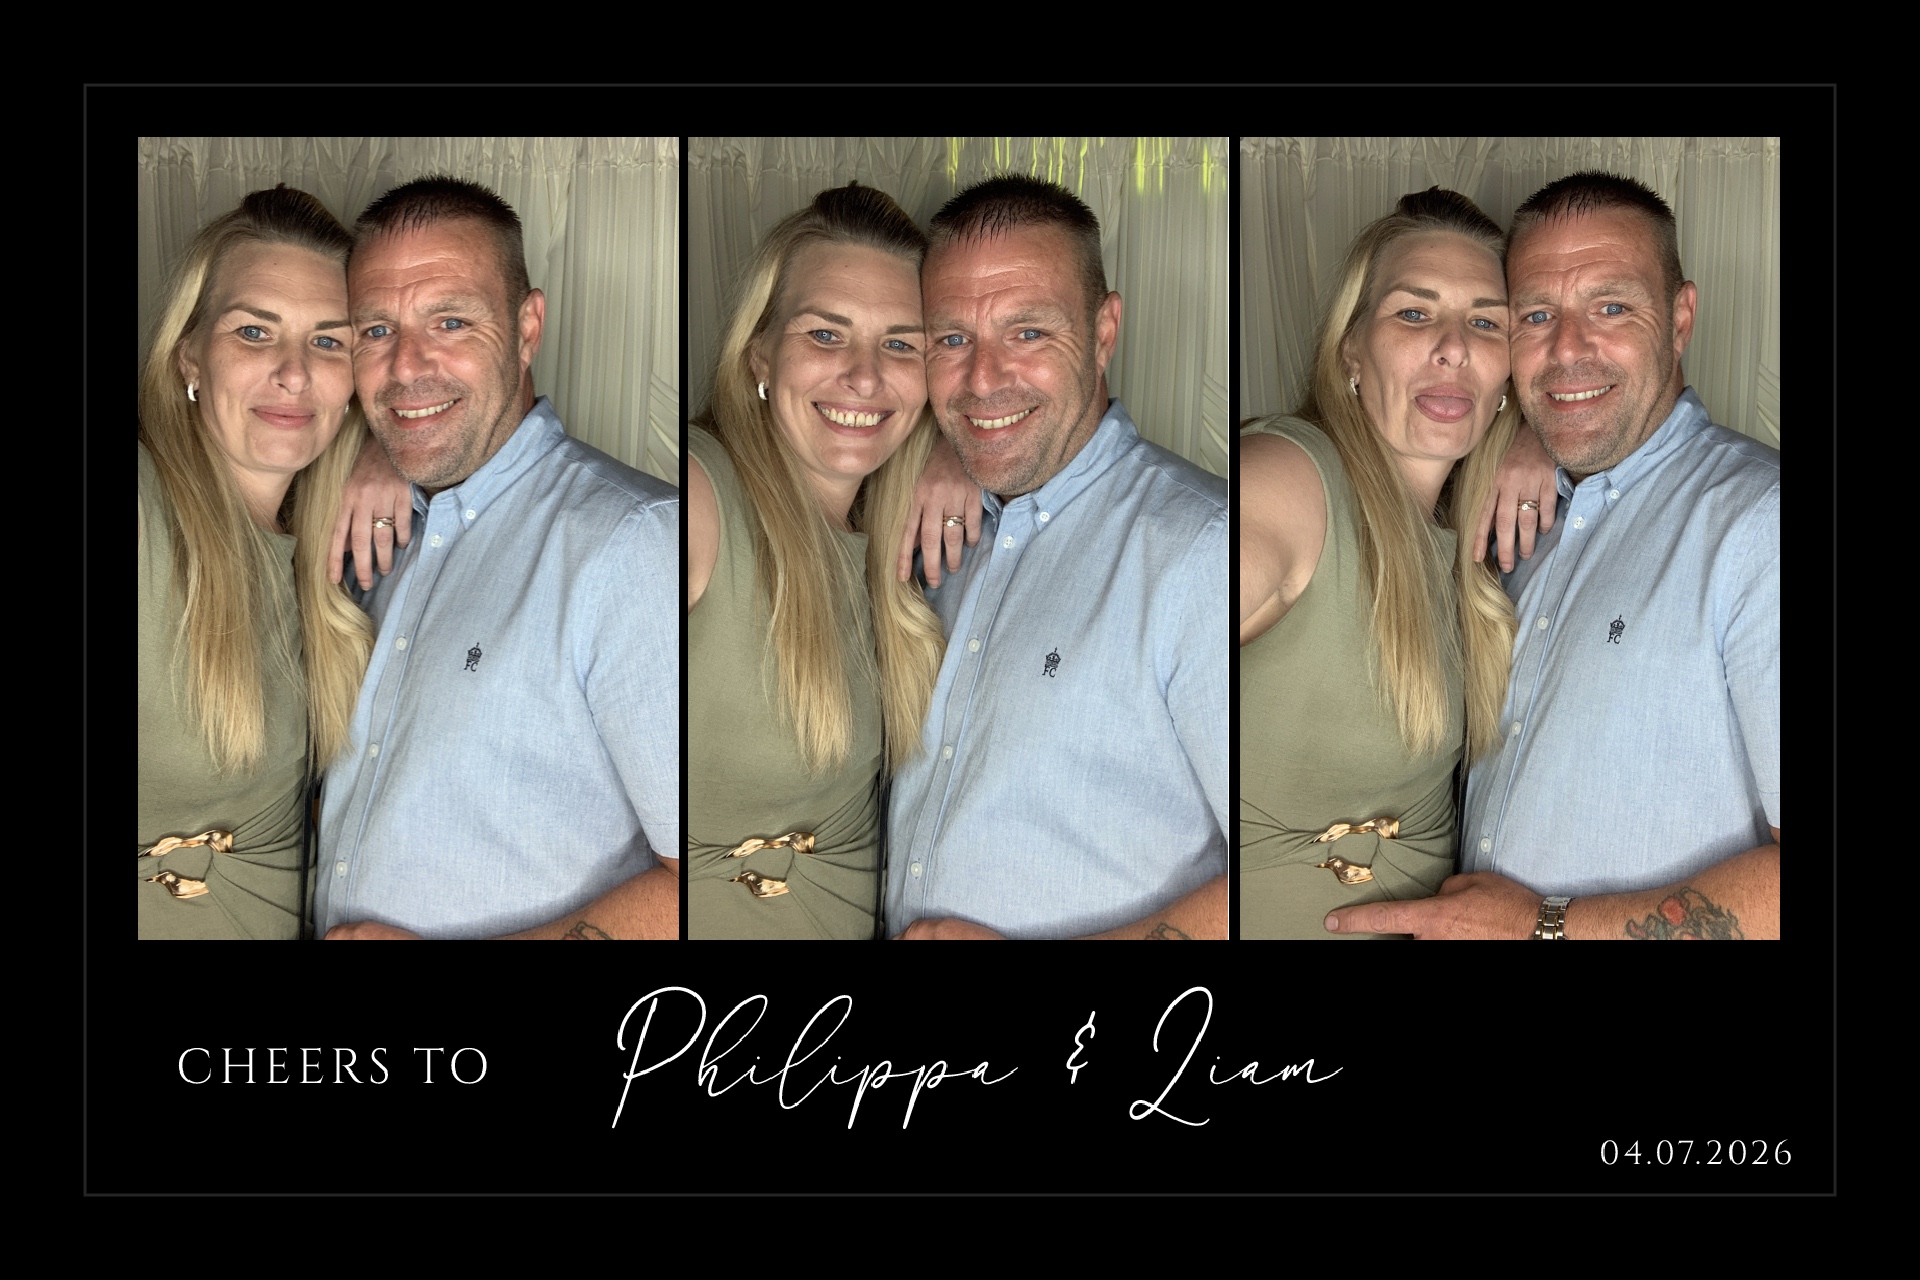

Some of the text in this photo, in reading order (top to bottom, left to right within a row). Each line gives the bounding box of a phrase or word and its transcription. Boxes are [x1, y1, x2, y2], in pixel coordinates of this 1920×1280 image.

[1607, 631, 1622, 645] FC
[463, 659, 479, 672] FC
[1042, 664, 1057, 678] FC
